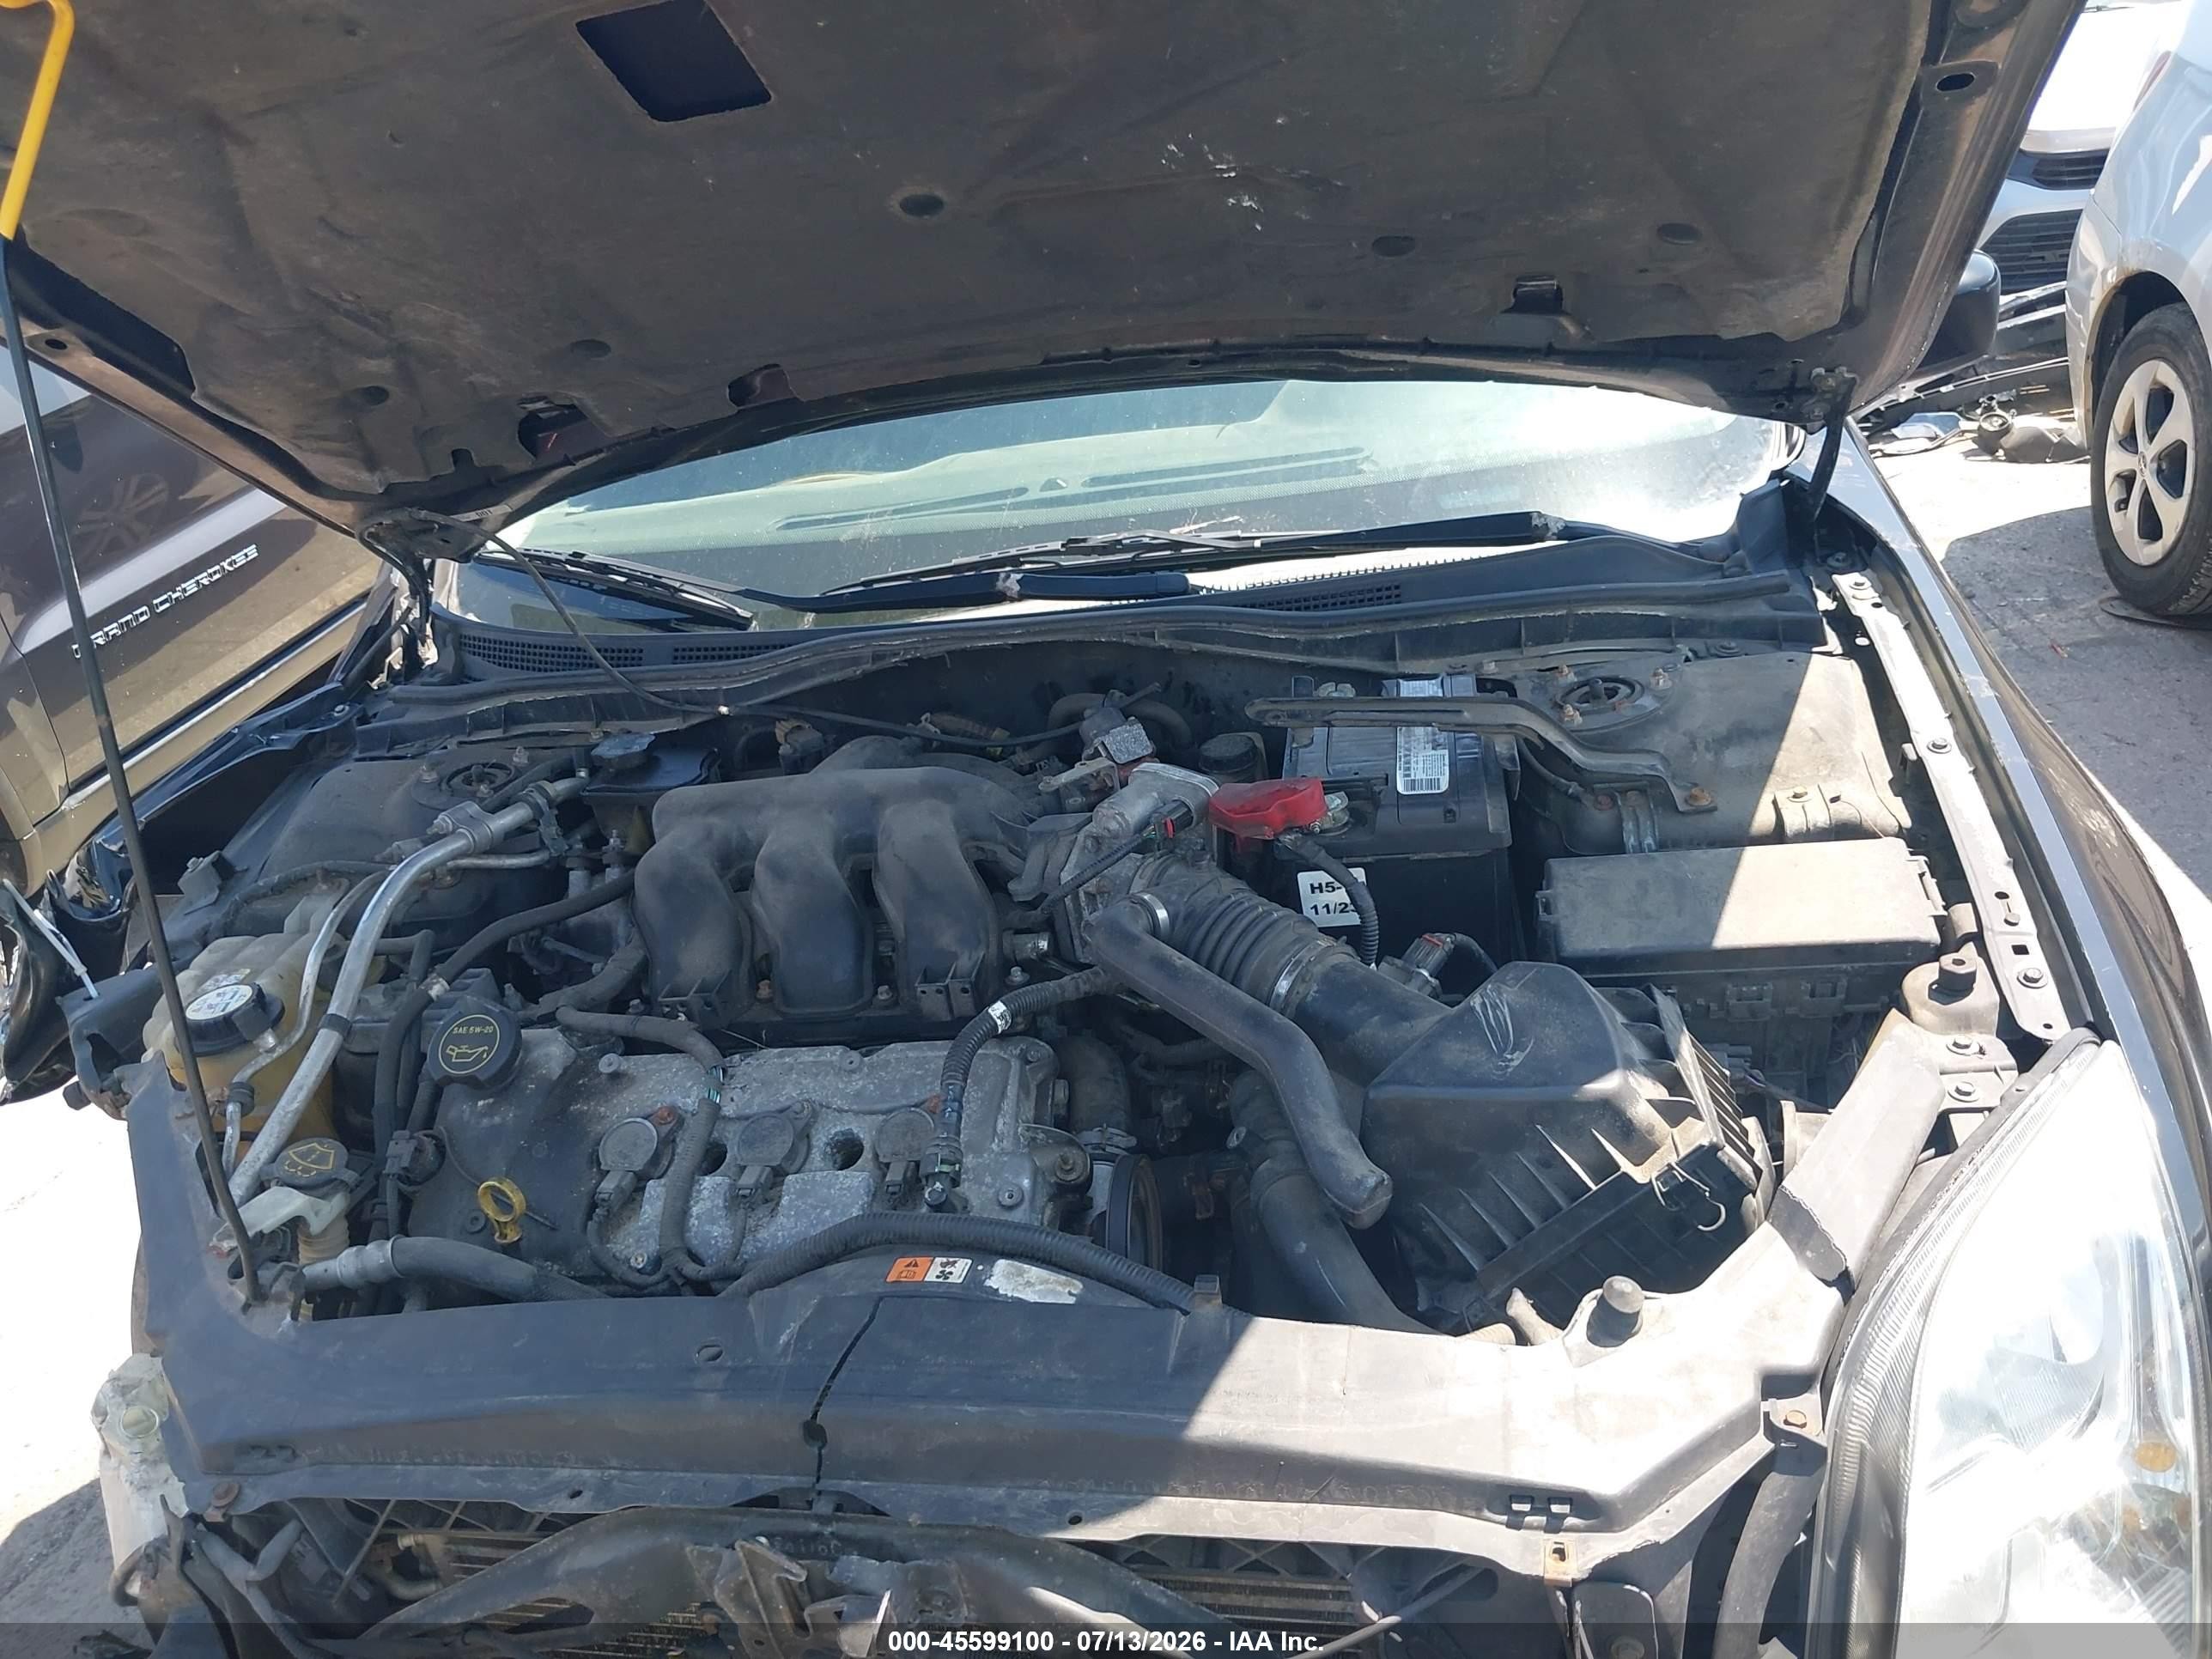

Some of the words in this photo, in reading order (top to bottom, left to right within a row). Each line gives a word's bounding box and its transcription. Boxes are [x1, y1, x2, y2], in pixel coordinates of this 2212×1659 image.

[152, 543, 259, 614] CHEROKEE
[453, 1026, 469, 1035] SAE
[469, 1025, 494, 1034] 5W-20
